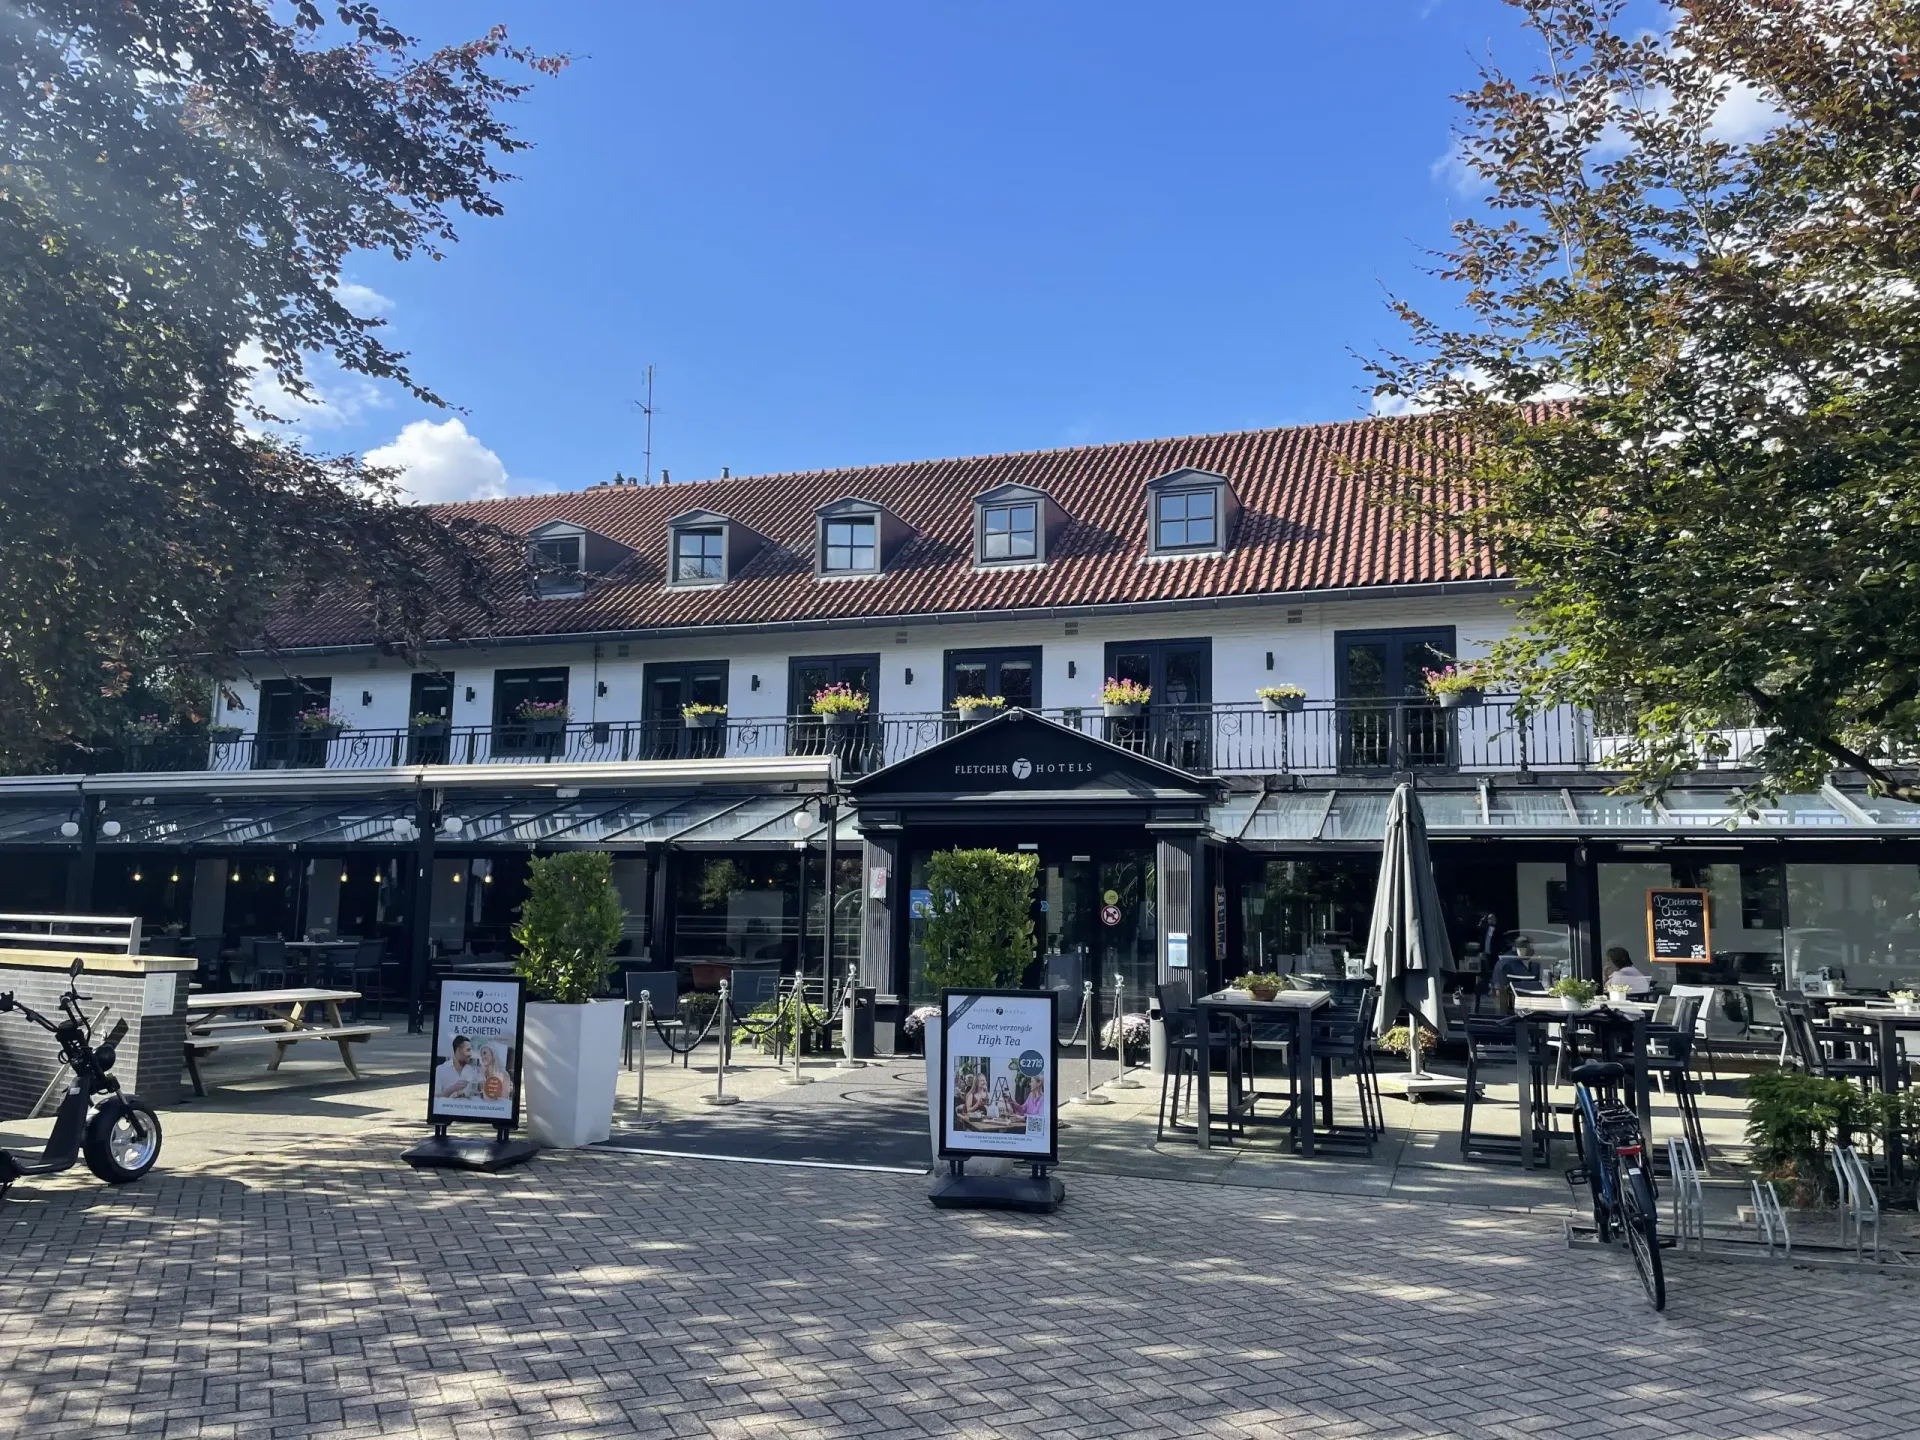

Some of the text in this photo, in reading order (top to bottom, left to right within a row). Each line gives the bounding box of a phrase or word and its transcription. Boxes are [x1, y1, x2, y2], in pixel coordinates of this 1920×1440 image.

[955, 764, 1009, 775] FLETCHER
[1036, 762, 1093, 774] HOTELS
[449, 1000, 509, 1014] EINDELOOS
[448, 1014, 508, 1025] ETEN, DRINKEN
[453, 1025, 501, 1036] & GENIETEN
[966, 1022, 1033, 1034] Compleet verzorgde
[977, 1034, 1022, 1048] High Tea
